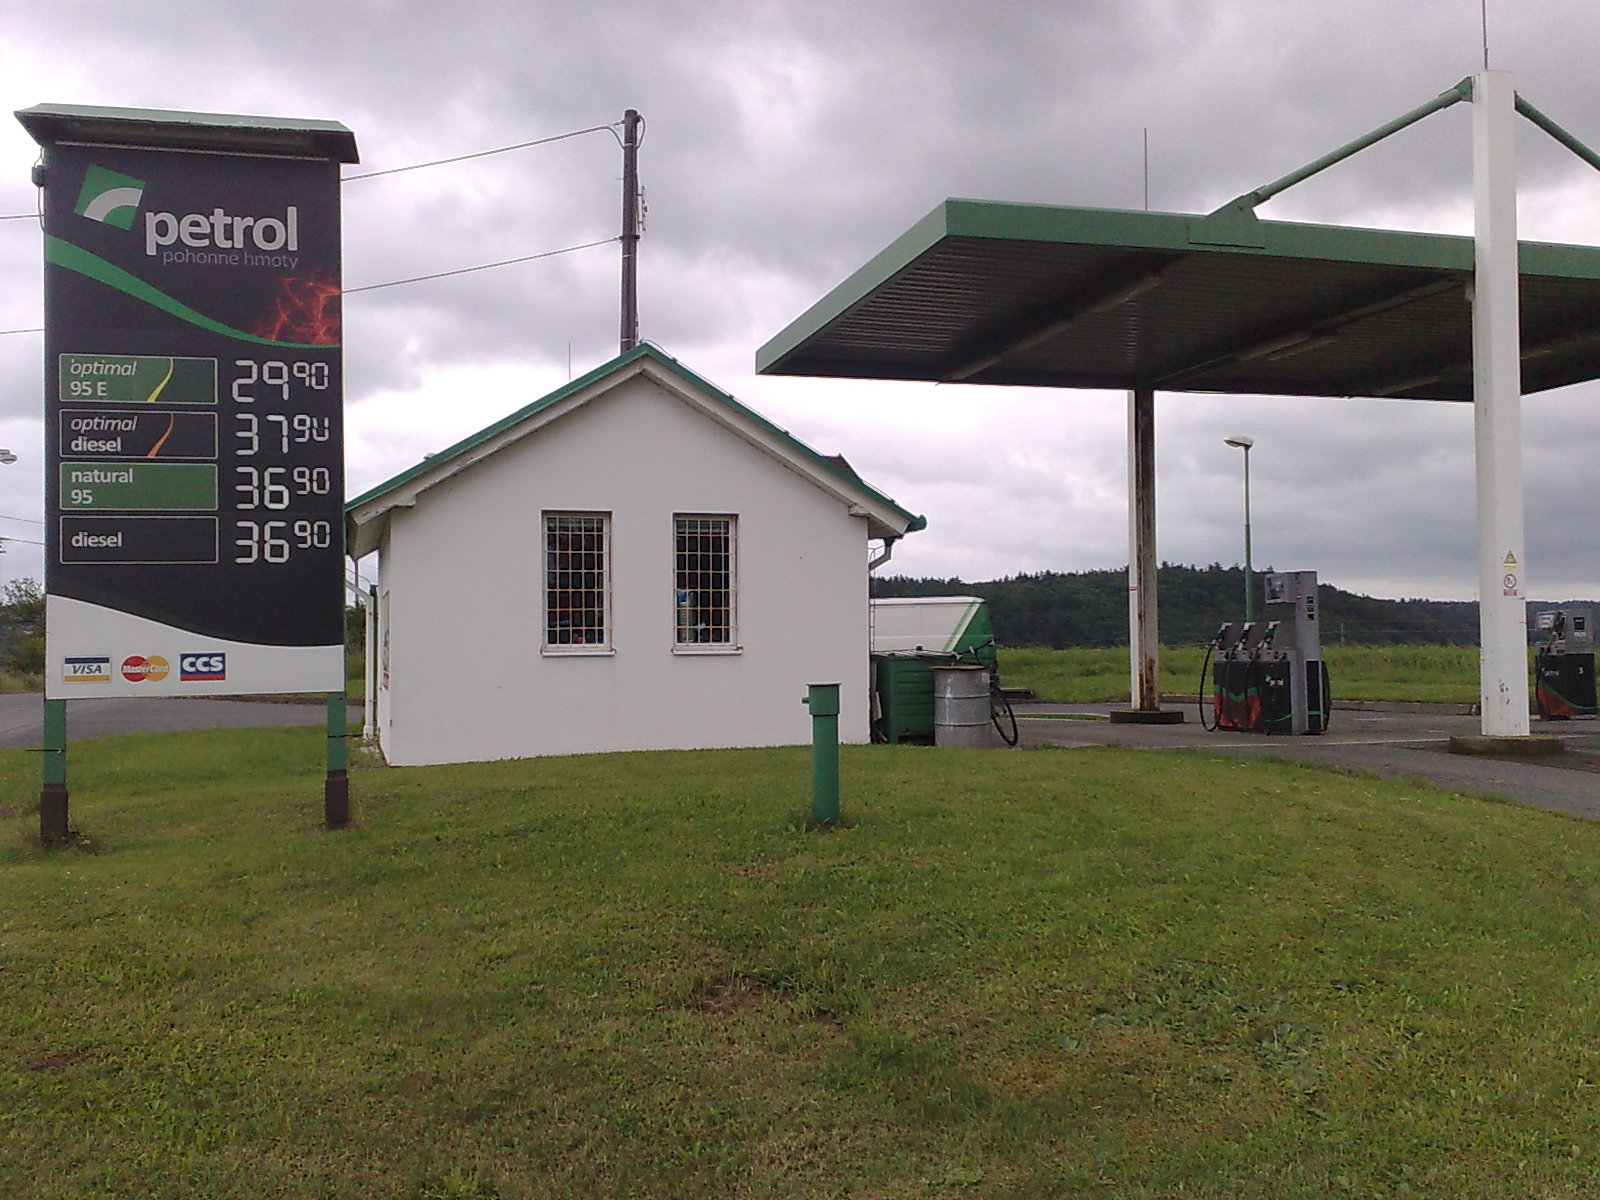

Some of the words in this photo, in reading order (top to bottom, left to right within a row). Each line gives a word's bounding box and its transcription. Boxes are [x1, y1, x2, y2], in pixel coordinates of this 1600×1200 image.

[145, 206, 298, 255] petrol
[162, 248, 239, 266] pohonné
[243, 252, 298, 270] hmoty
[70, 360, 137, 379] optimal
[70, 381, 93, 396] 95
[97, 382, 107, 397] E
[70, 416, 138, 434] optimal
[70, 437, 122, 452] diesel
[71, 468, 133, 483] natural
[71, 489, 93, 504] 95
[71, 532, 123, 547] diesel
[71, 664, 103, 675] VISA
[182, 656, 224, 673] CCS
